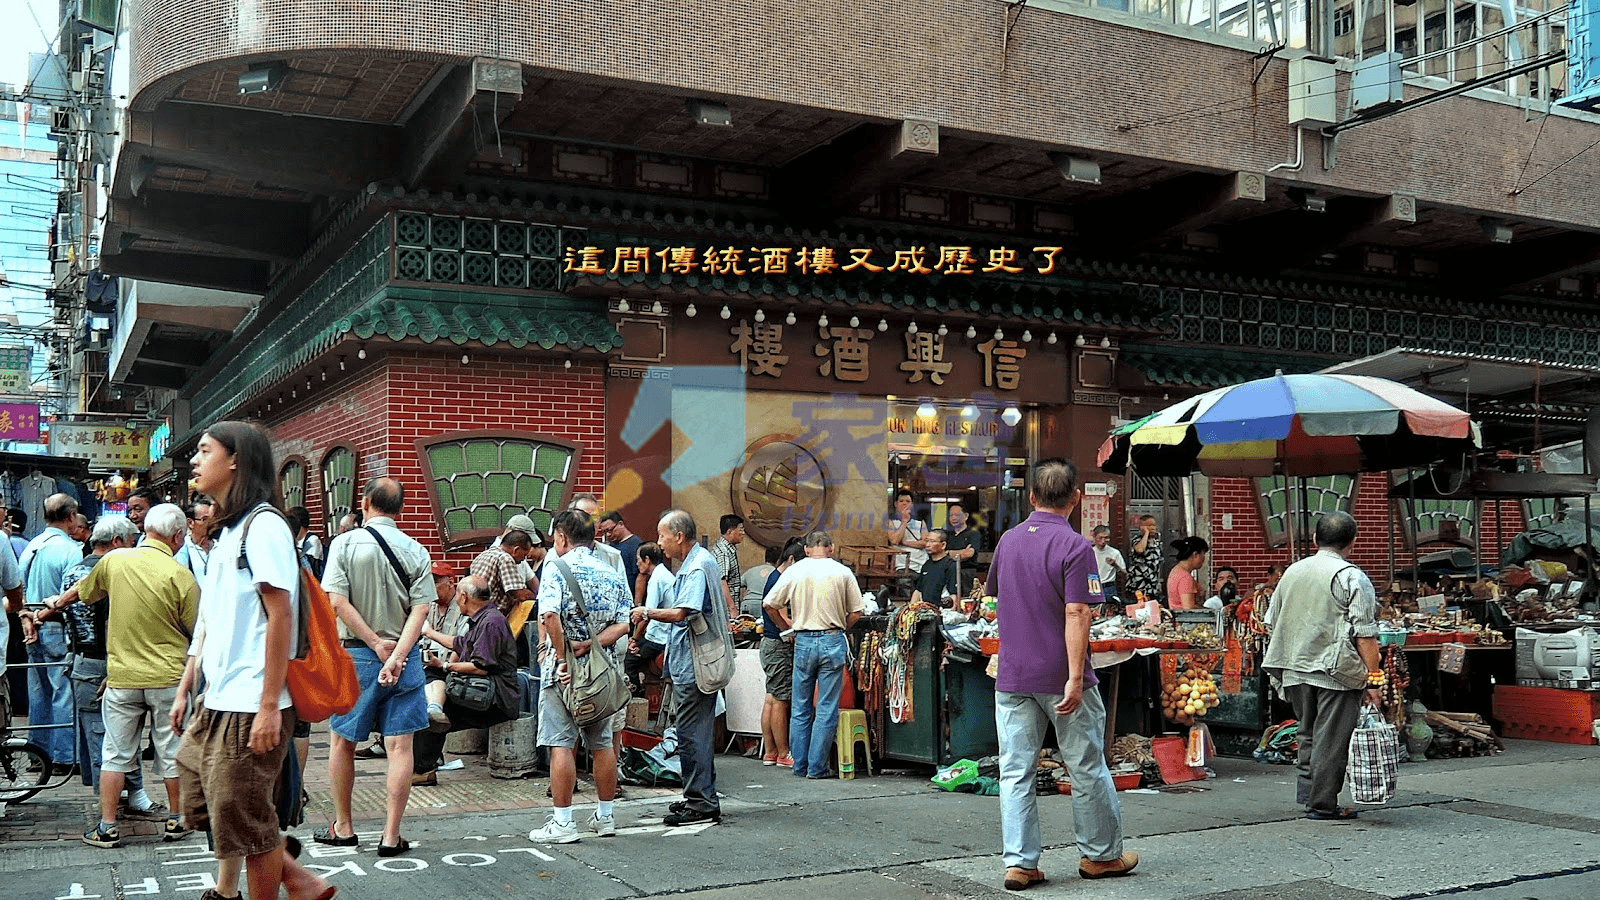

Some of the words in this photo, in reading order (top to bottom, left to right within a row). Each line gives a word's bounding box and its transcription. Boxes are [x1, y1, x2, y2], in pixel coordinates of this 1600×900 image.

[729, 318, 1028, 390] 信興酒樓
[887, 417, 908, 434] UN
[911, 417, 941, 436] HING
[302, 846, 556, 880] LOOK
[55, 870, 247, 900] EFT
